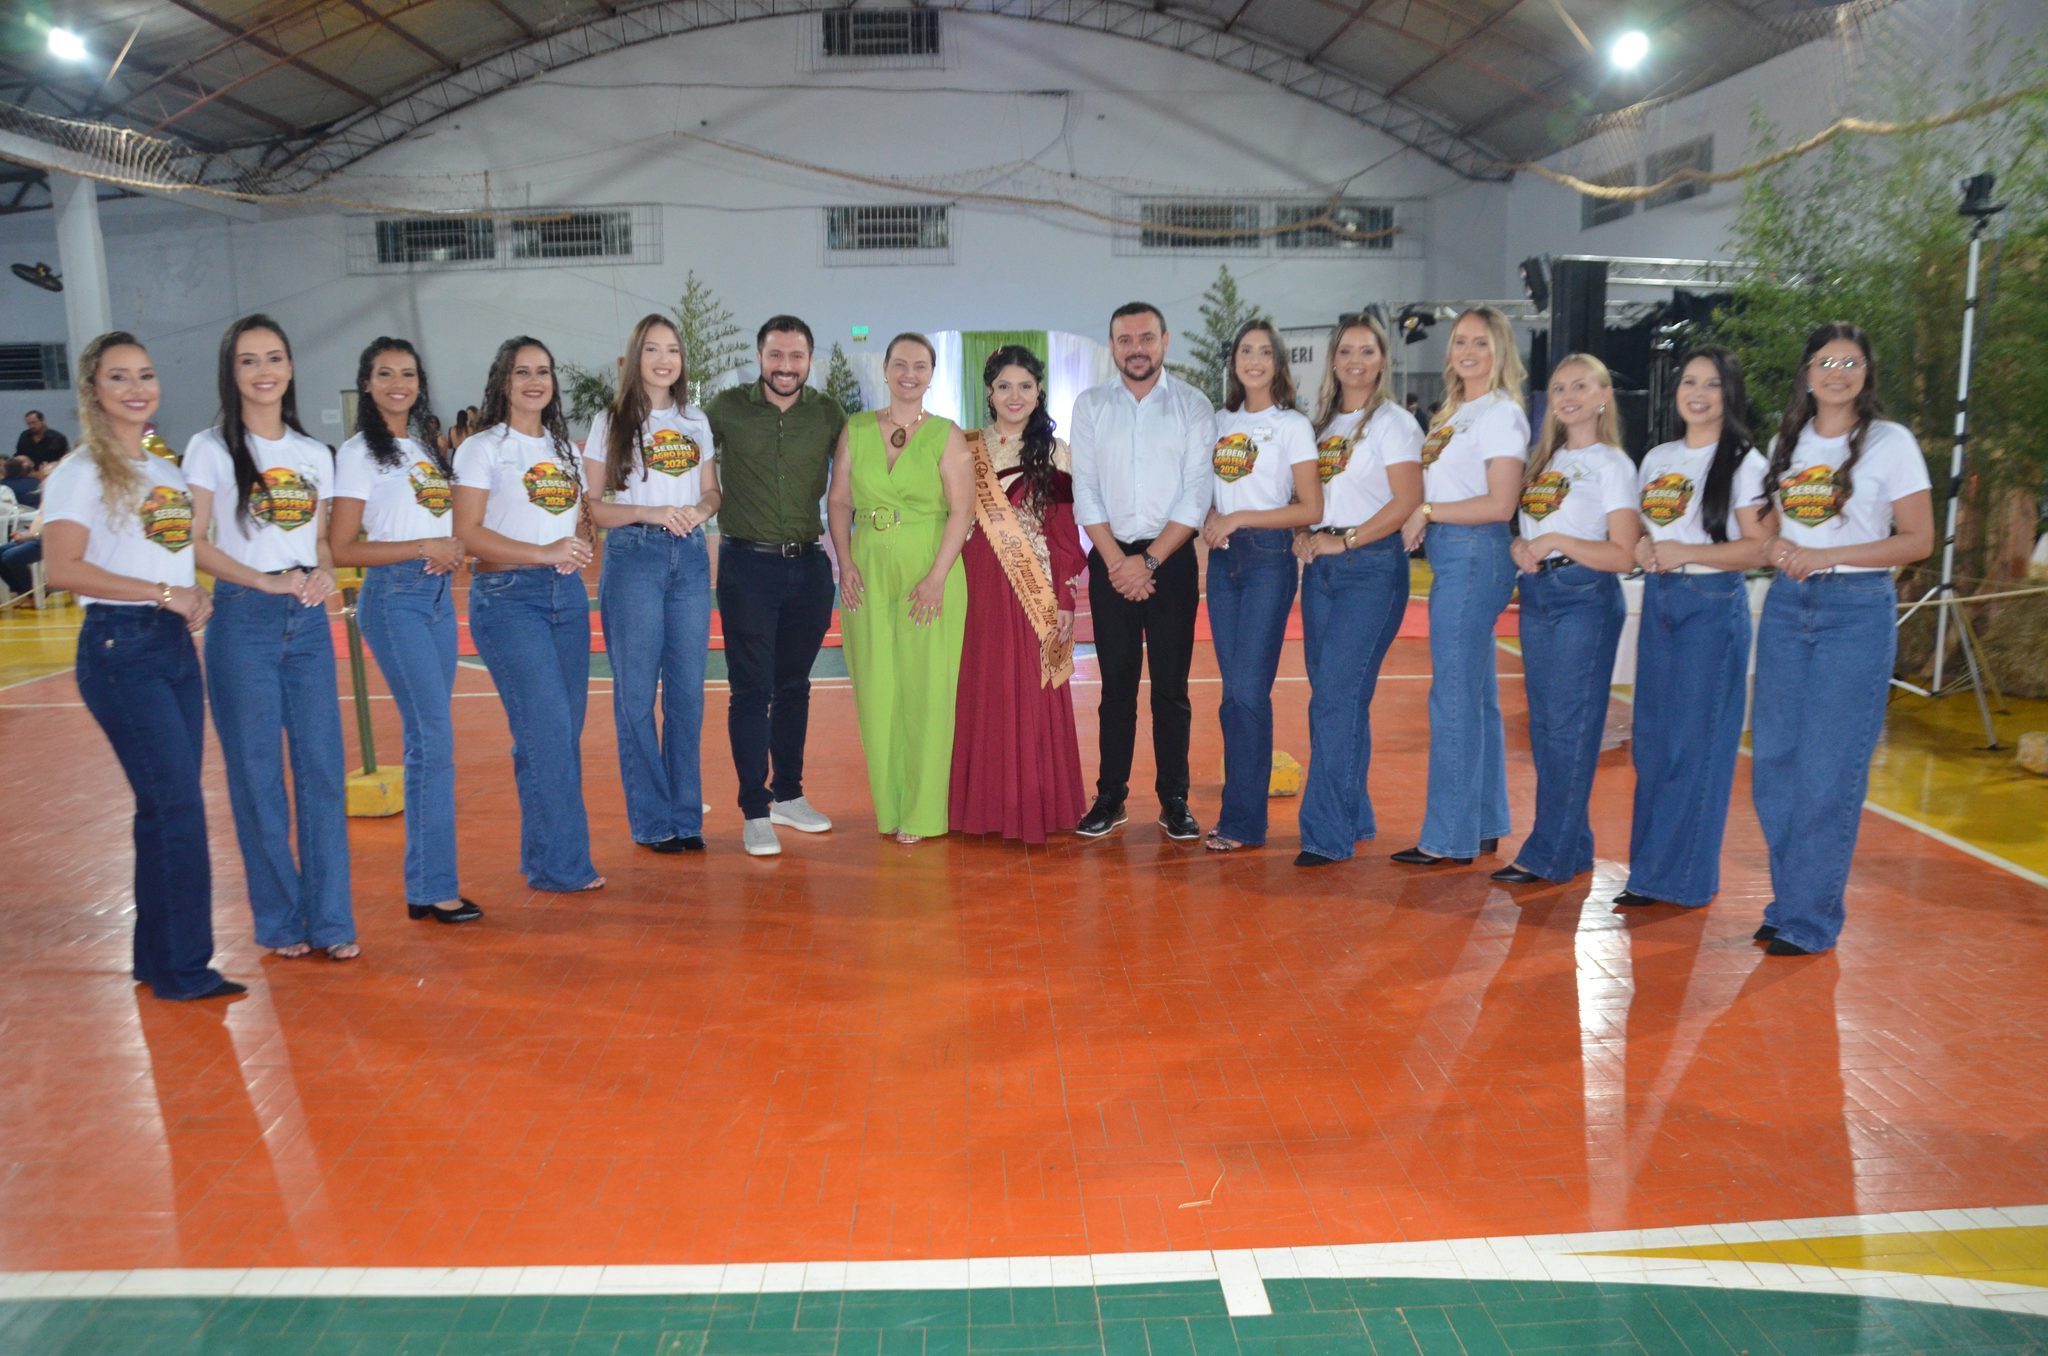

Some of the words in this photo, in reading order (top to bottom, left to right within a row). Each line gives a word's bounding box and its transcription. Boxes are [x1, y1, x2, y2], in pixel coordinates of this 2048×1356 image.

[653, 444, 692, 453] SEBERI
[1216, 449, 1247, 458] SEBERI
[652, 451, 676, 462] AGRO
[676, 451, 696, 460] FEST
[663, 459, 688, 469] 2026
[1220, 464, 1239, 474] 2026
[535, 480, 571, 488] SEBERI
[269, 489, 308, 500] EBERI
[544, 496, 567, 506] 2026
[1012, 556, 1044, 595] Grande
